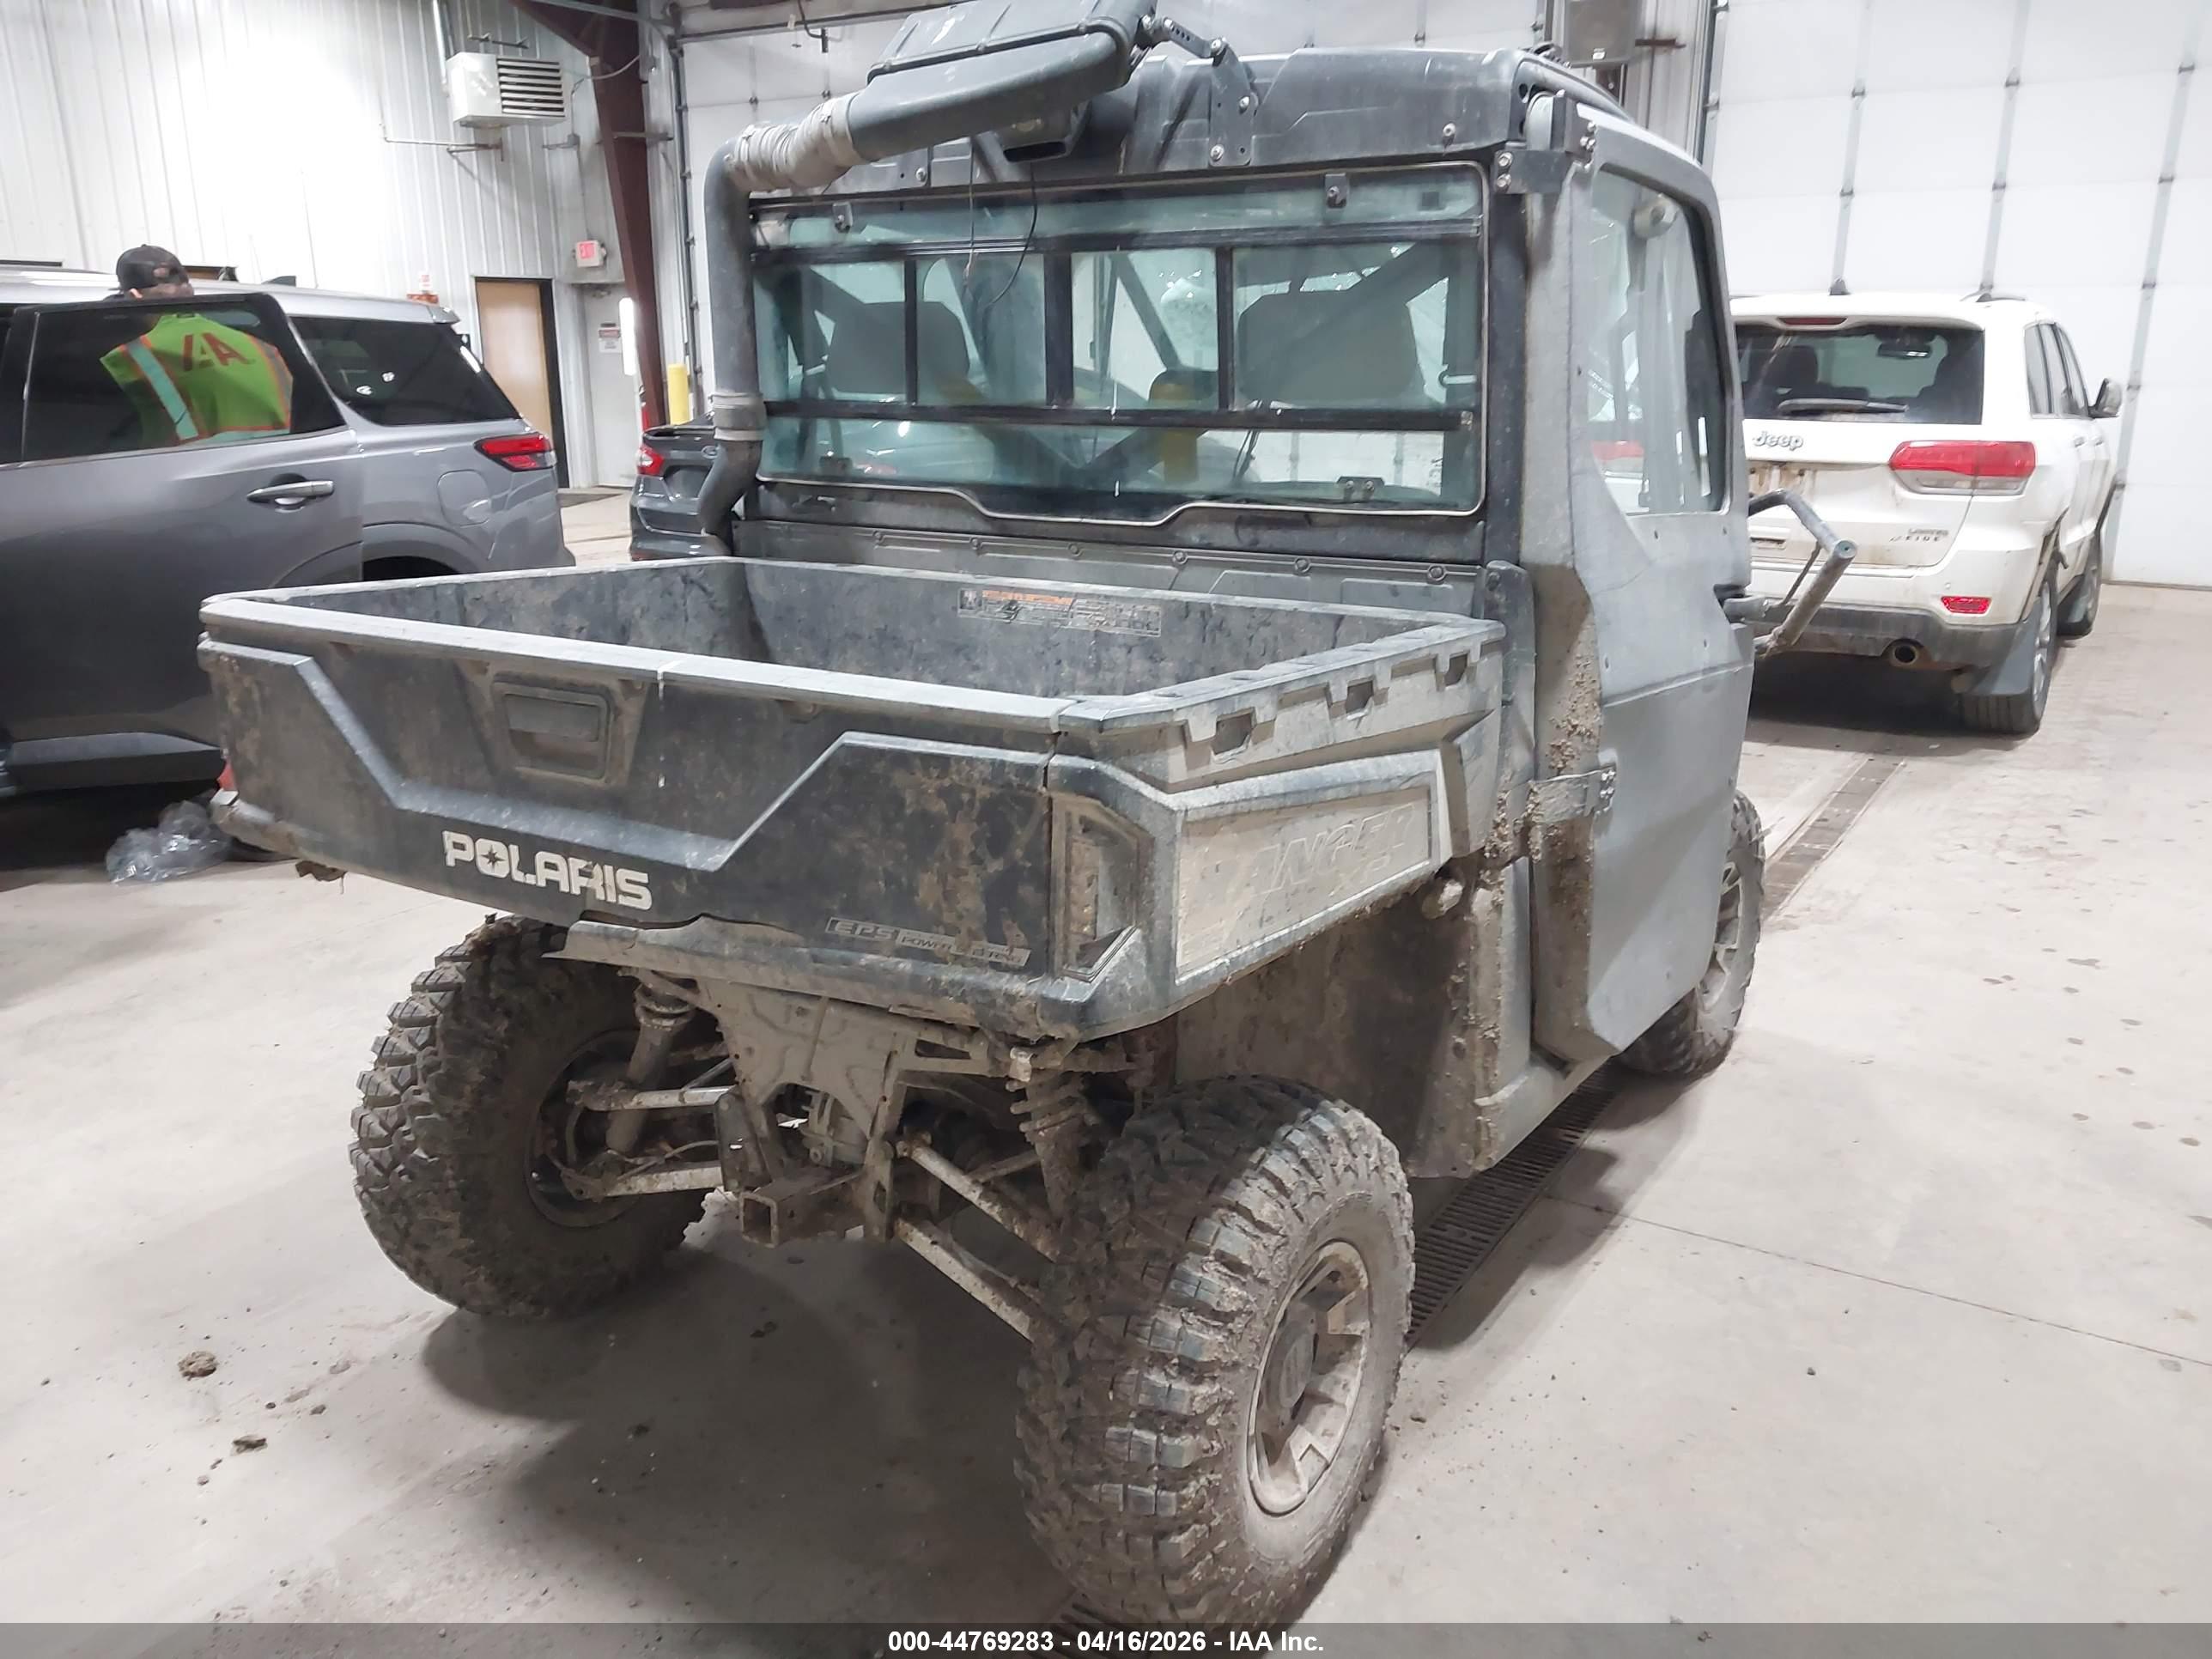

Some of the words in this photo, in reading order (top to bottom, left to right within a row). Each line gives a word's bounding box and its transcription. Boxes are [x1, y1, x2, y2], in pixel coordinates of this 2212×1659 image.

[1752, 430, 1804, 452] Jeep
[441, 830, 653, 910] POLARIS
[835, 921, 896, 940] EPS
